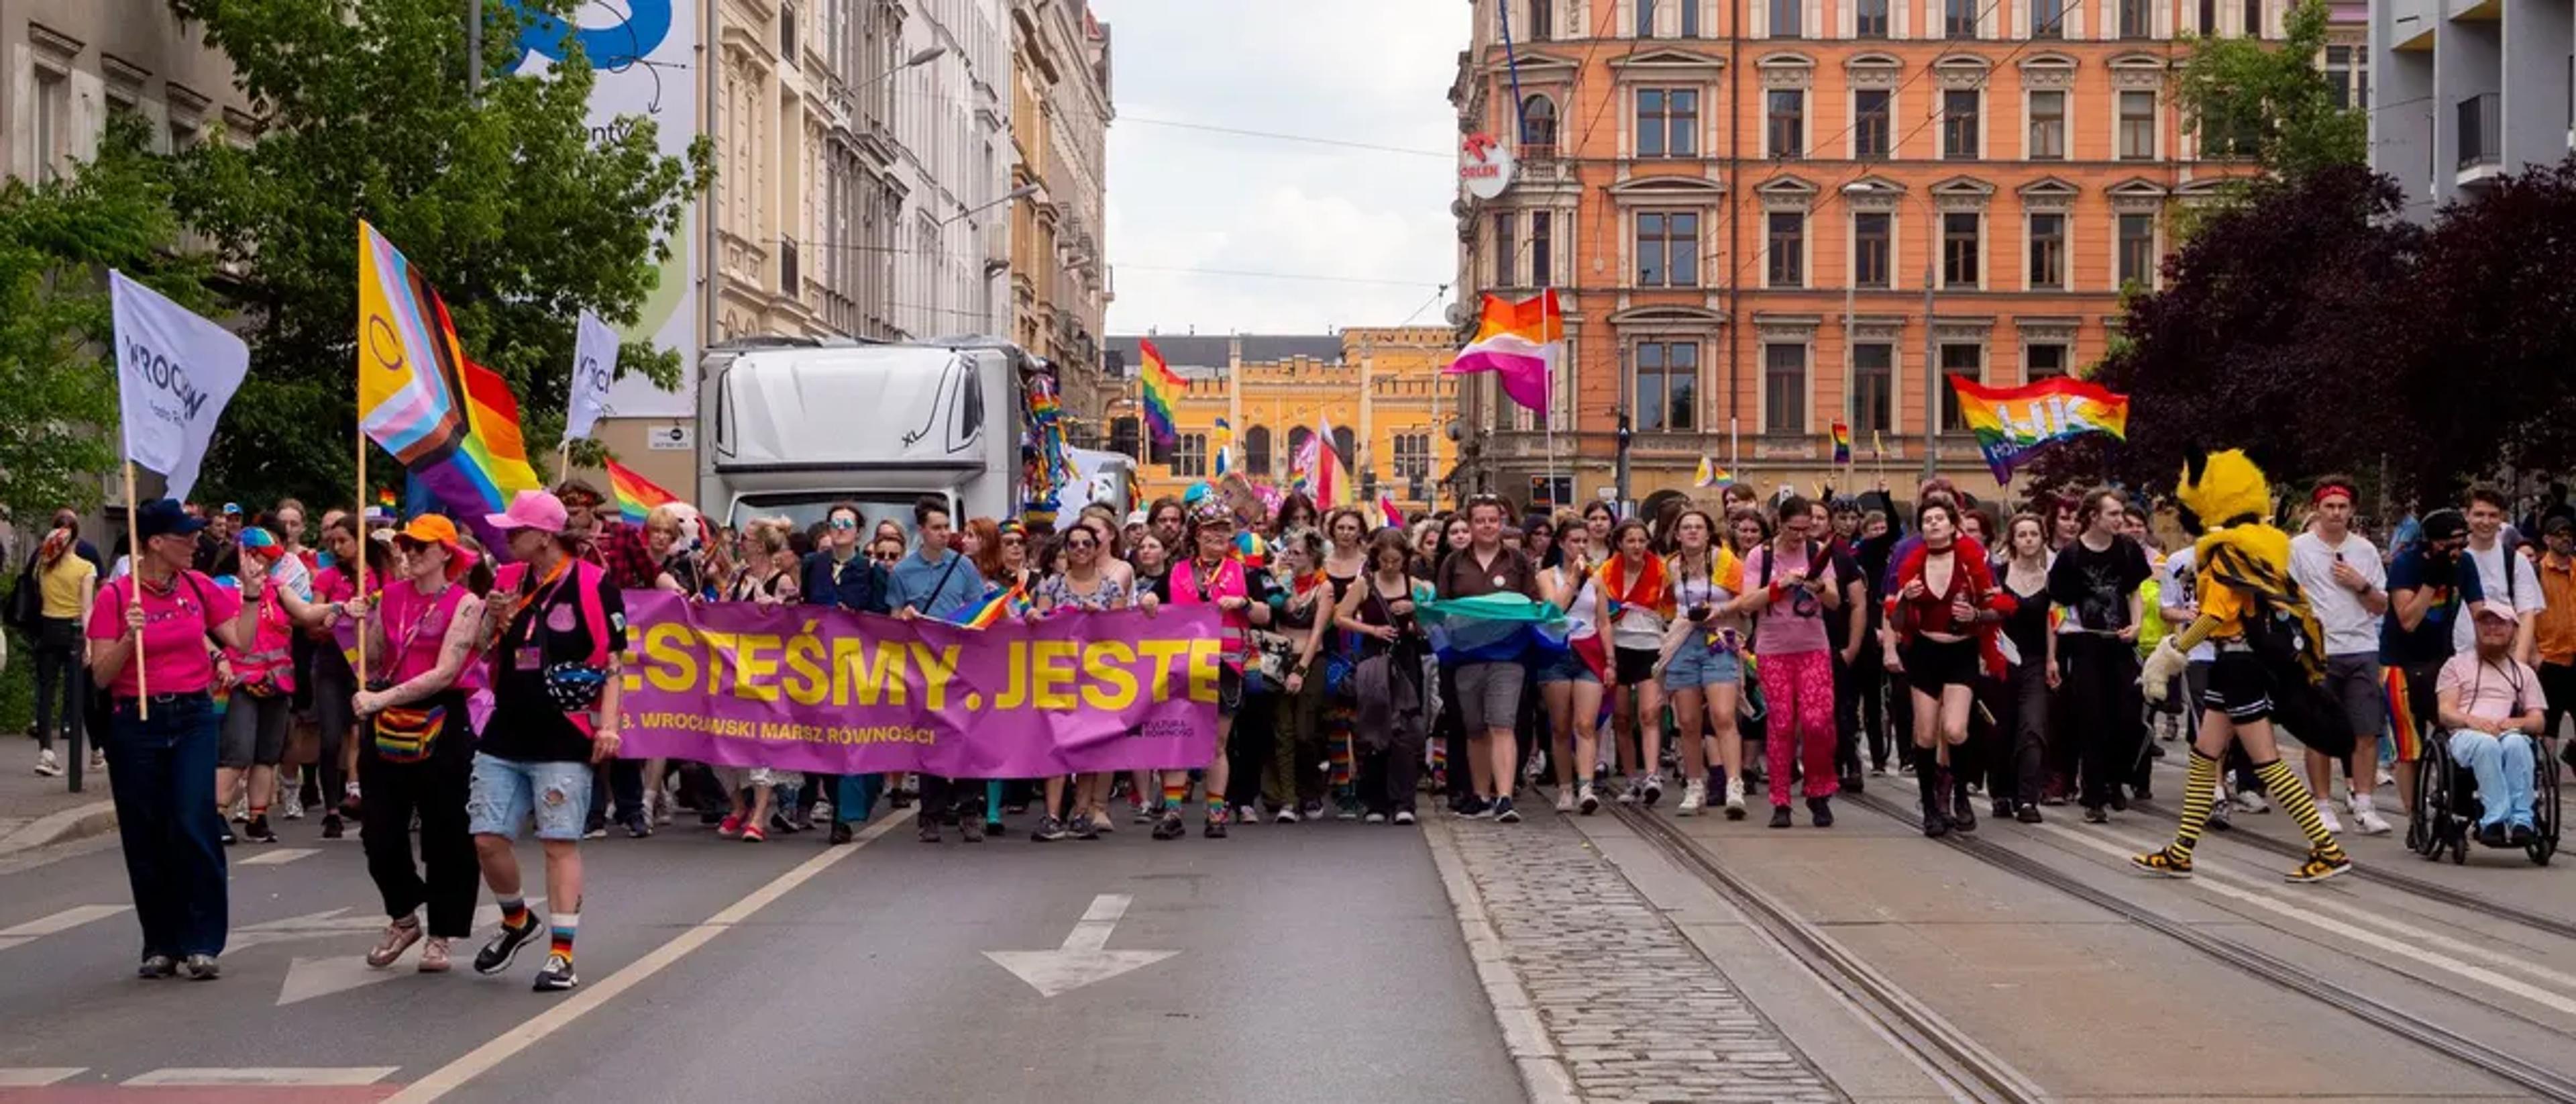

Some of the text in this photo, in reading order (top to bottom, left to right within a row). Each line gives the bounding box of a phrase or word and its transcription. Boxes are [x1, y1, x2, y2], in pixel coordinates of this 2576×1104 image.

[1460, 164, 1499, 179] ORLEN
[902, 430, 920, 448] XL
[994, 639, 1221, 711] JESTE
[760, 721, 824, 743] MARSZ
[827, 725, 936, 745] RÓWNOŚCI
